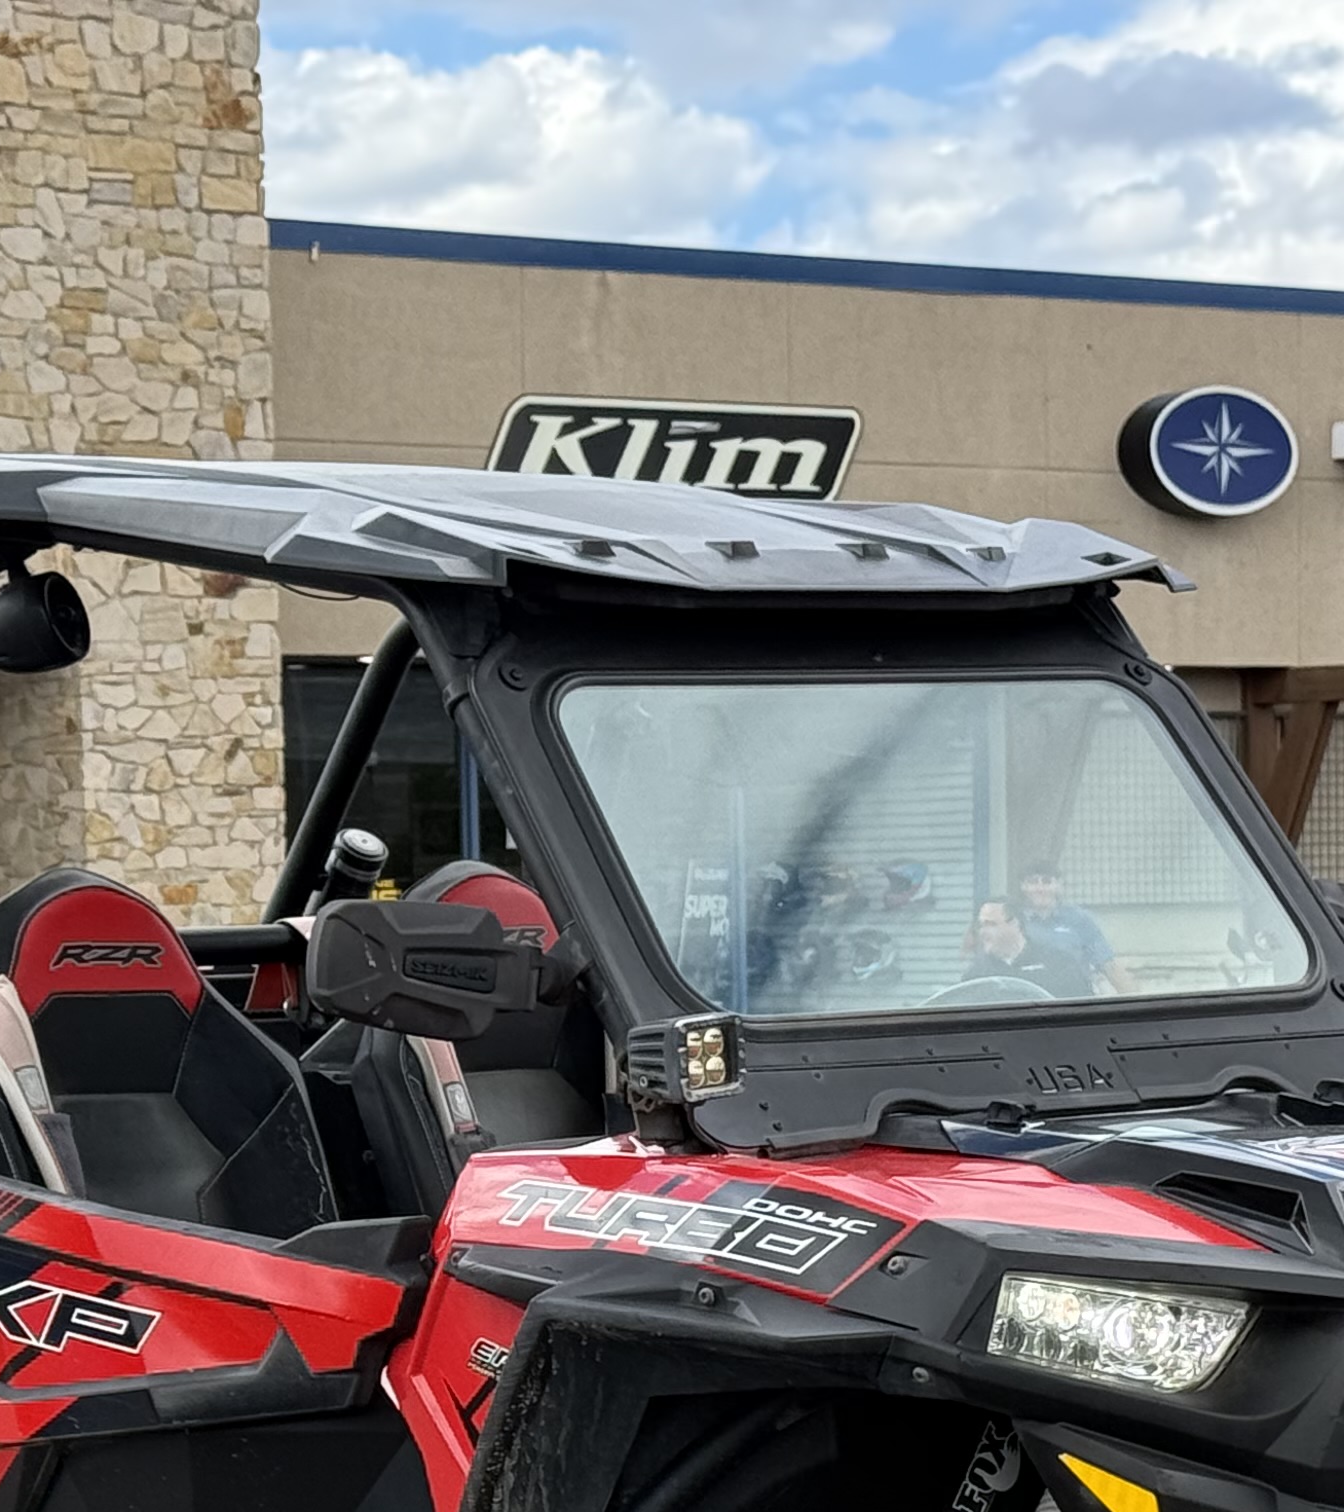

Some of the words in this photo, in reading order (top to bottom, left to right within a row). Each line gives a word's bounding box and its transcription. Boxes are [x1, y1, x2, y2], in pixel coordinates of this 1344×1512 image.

[49, 942, 165, 970] RZR
[1028, 1063, 1114, 1094] USA
[497, 1180, 849, 1276] TURBO
[742, 1197, 878, 1236] DOHC
